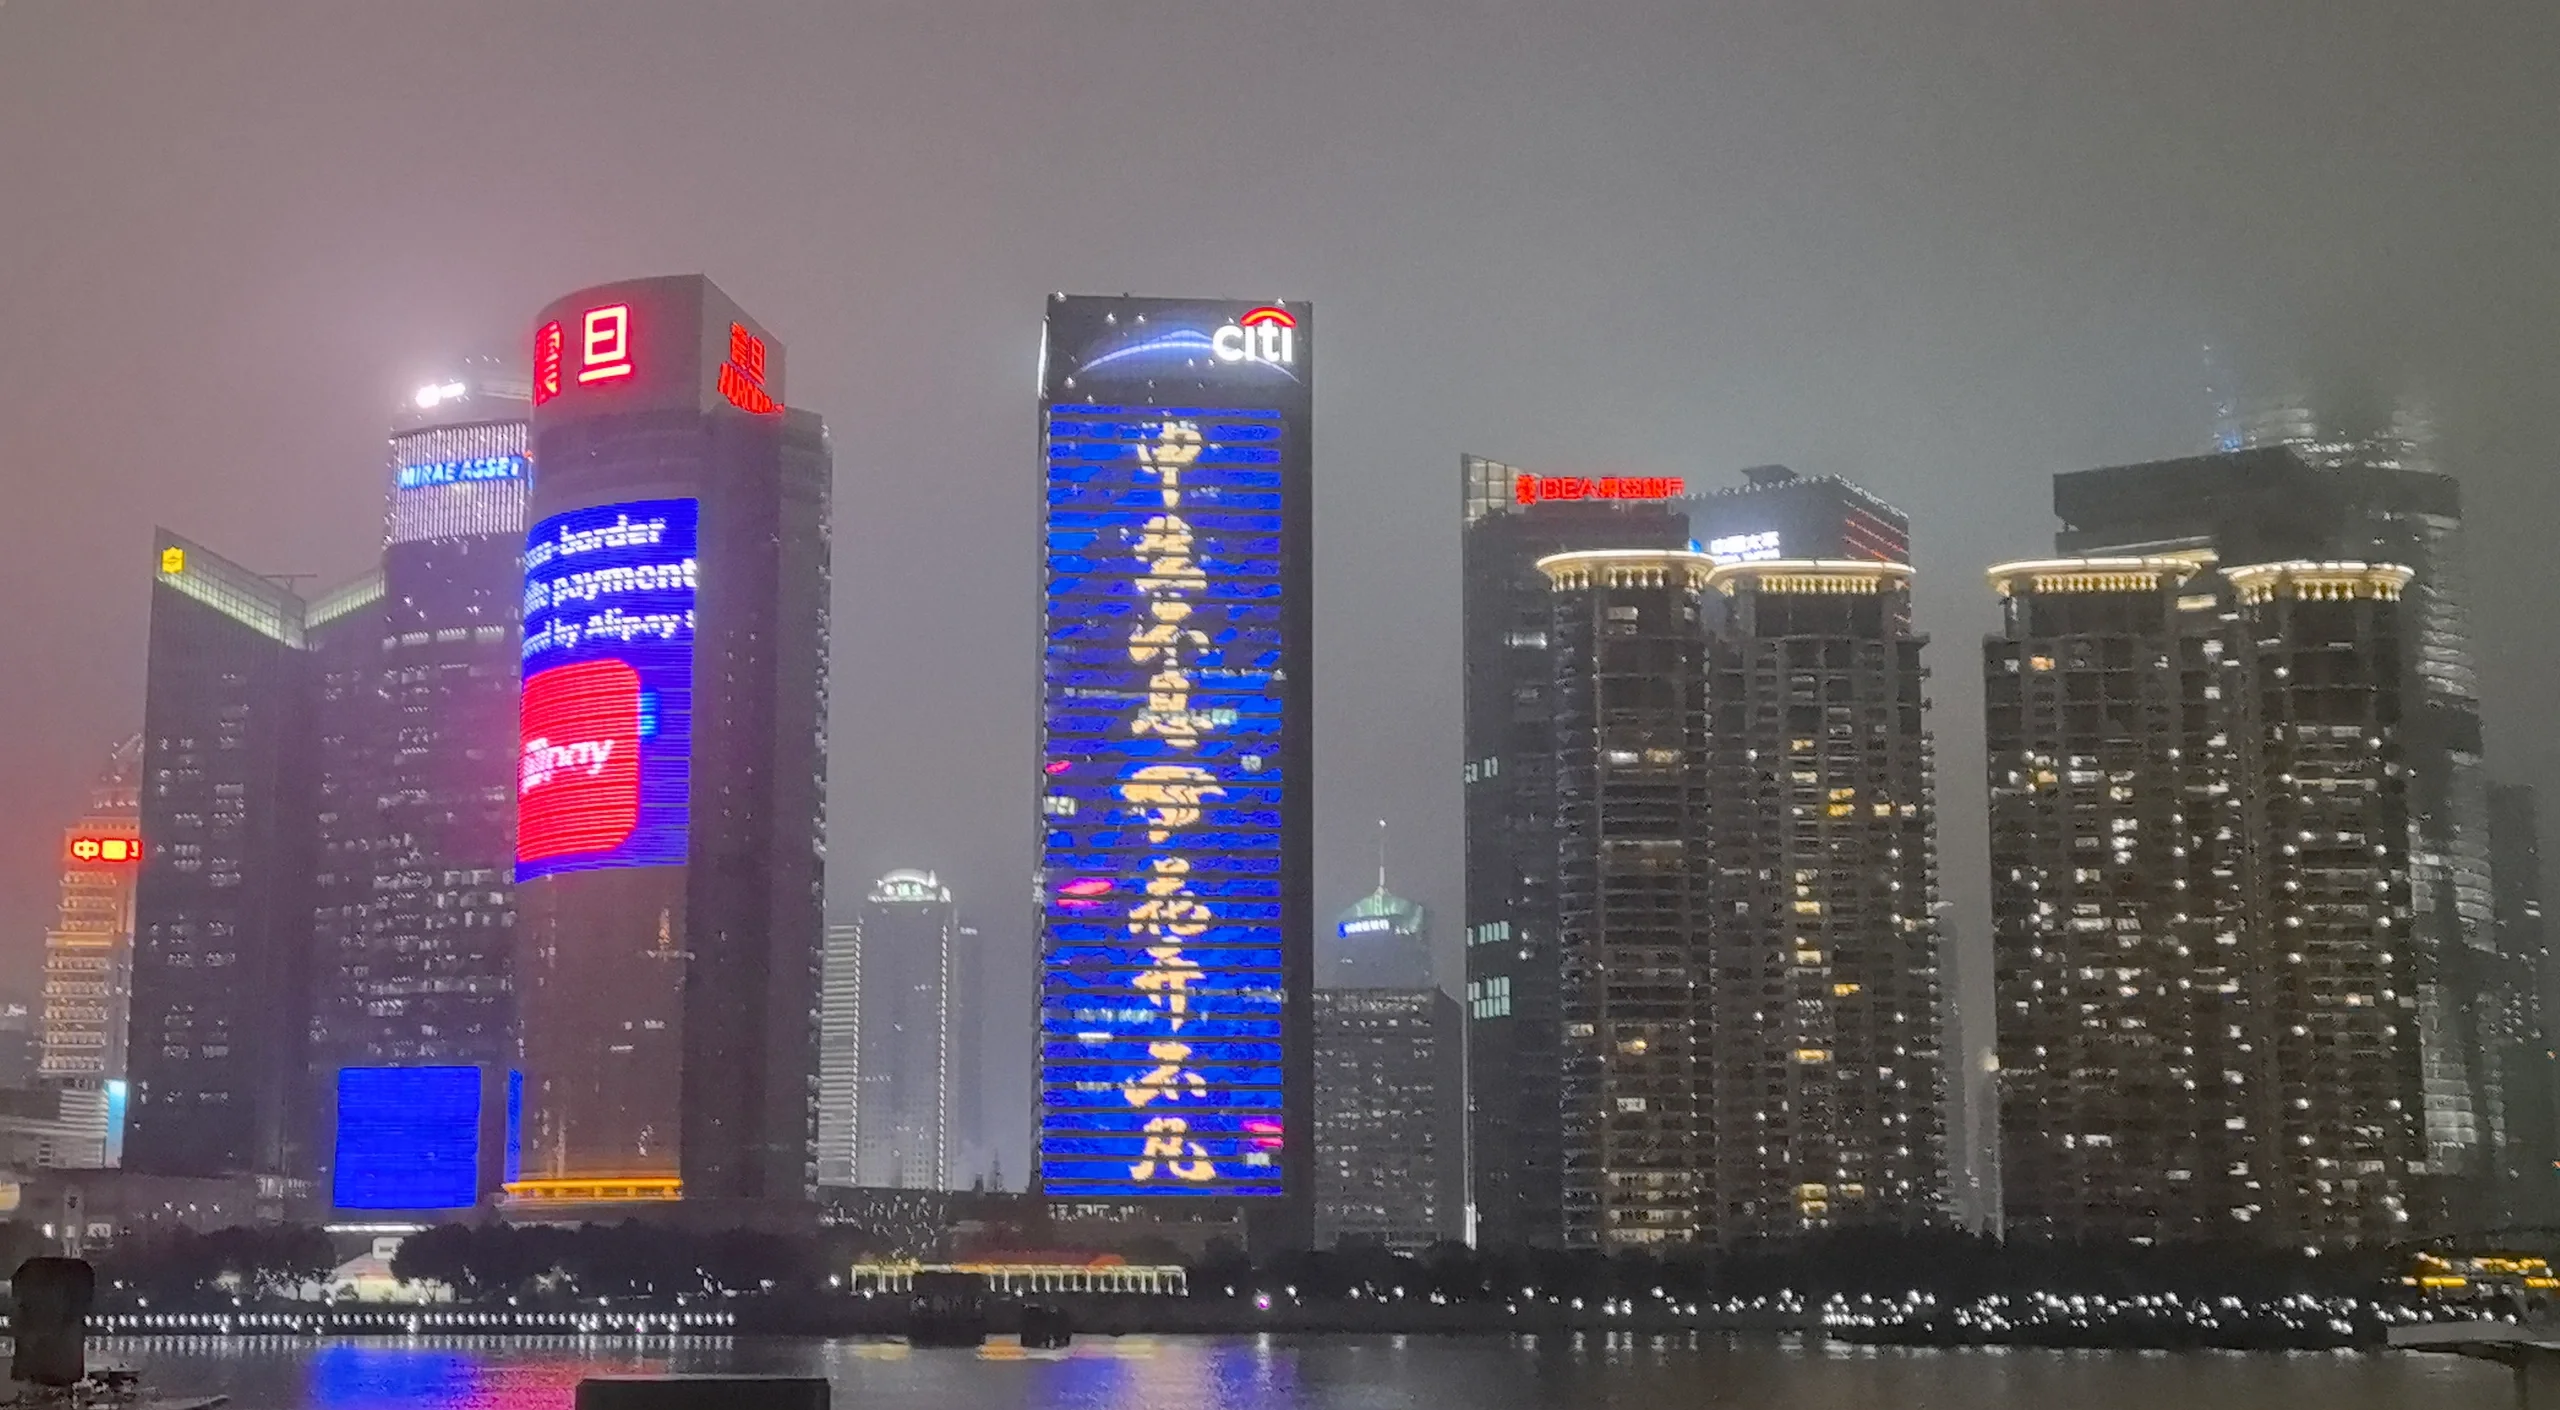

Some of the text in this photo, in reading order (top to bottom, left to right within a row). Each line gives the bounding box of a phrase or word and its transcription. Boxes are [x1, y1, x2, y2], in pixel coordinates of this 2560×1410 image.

[1213, 318, 1292, 362] citi
[399, 456, 523, 489] MIRAE ASSET
